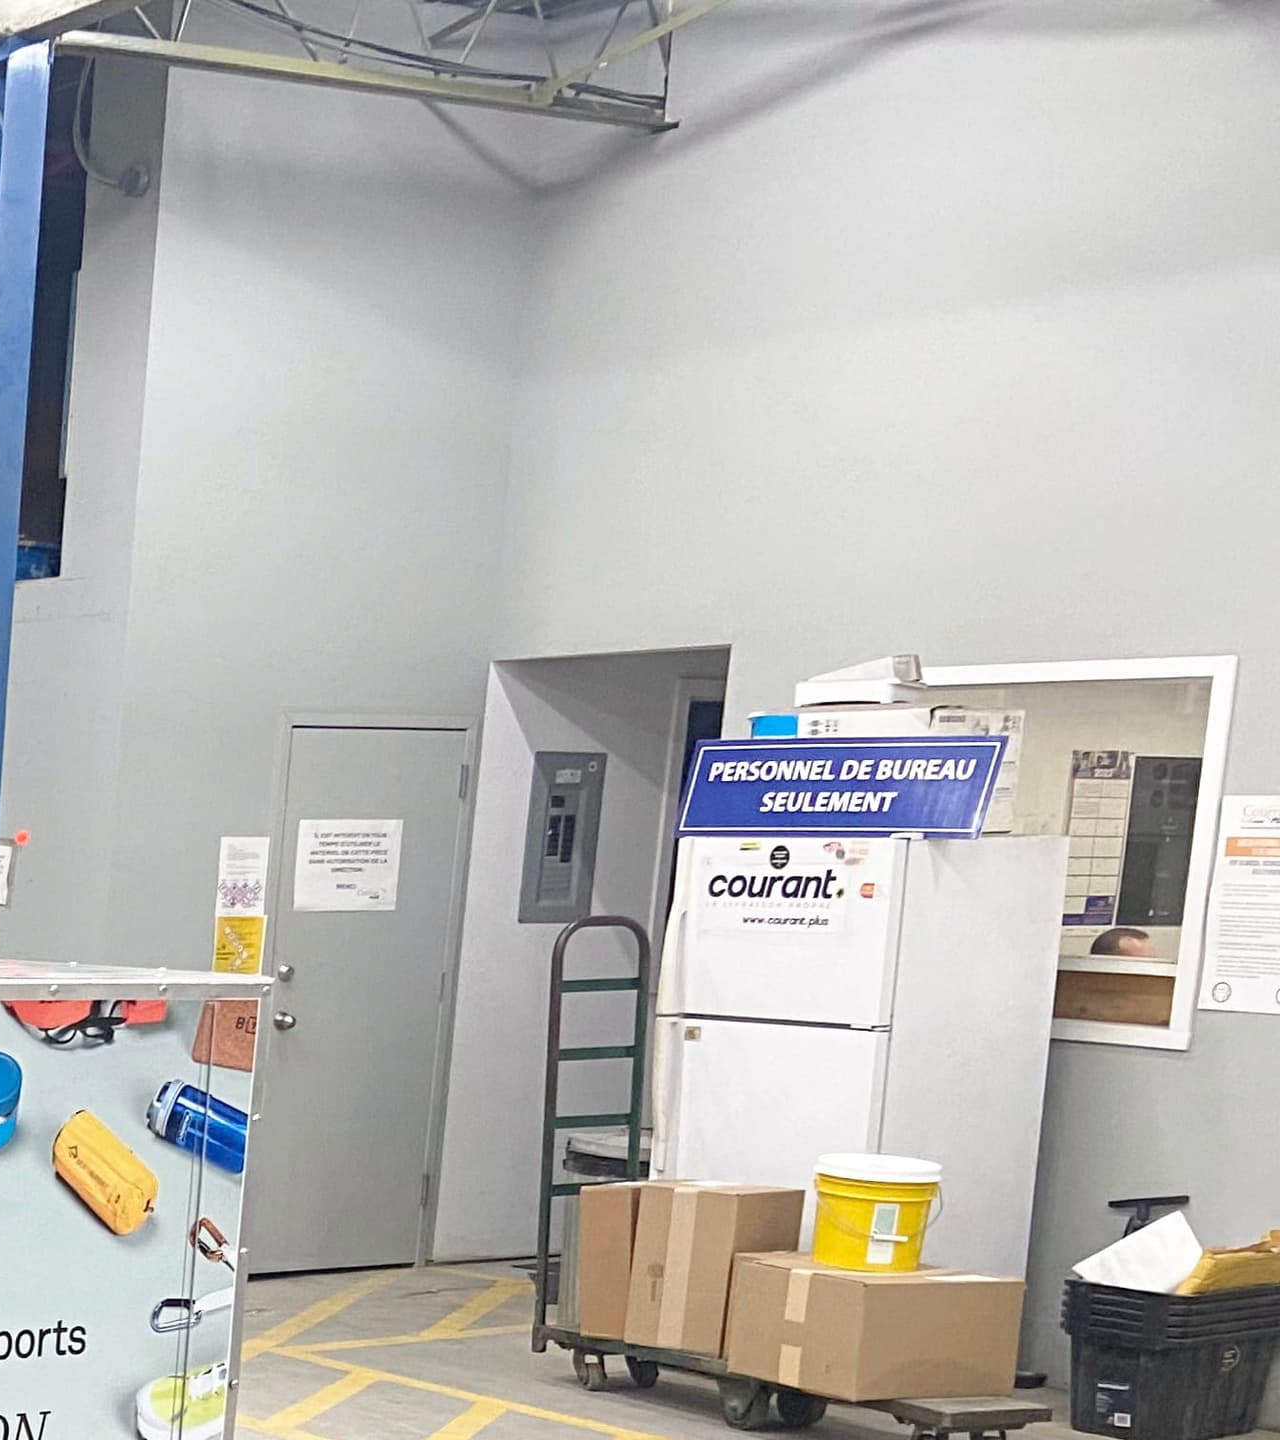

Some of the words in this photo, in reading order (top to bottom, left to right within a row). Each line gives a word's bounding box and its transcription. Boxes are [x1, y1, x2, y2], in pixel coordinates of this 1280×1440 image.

[708, 759, 835, 782] PERSONNEL
[840, 759, 873, 781] DE
[876, 758, 977, 781] BUREAU
[759, 791, 898, 813] SEULEMENT
[742, 915, 830, 928] www.courant.plus
